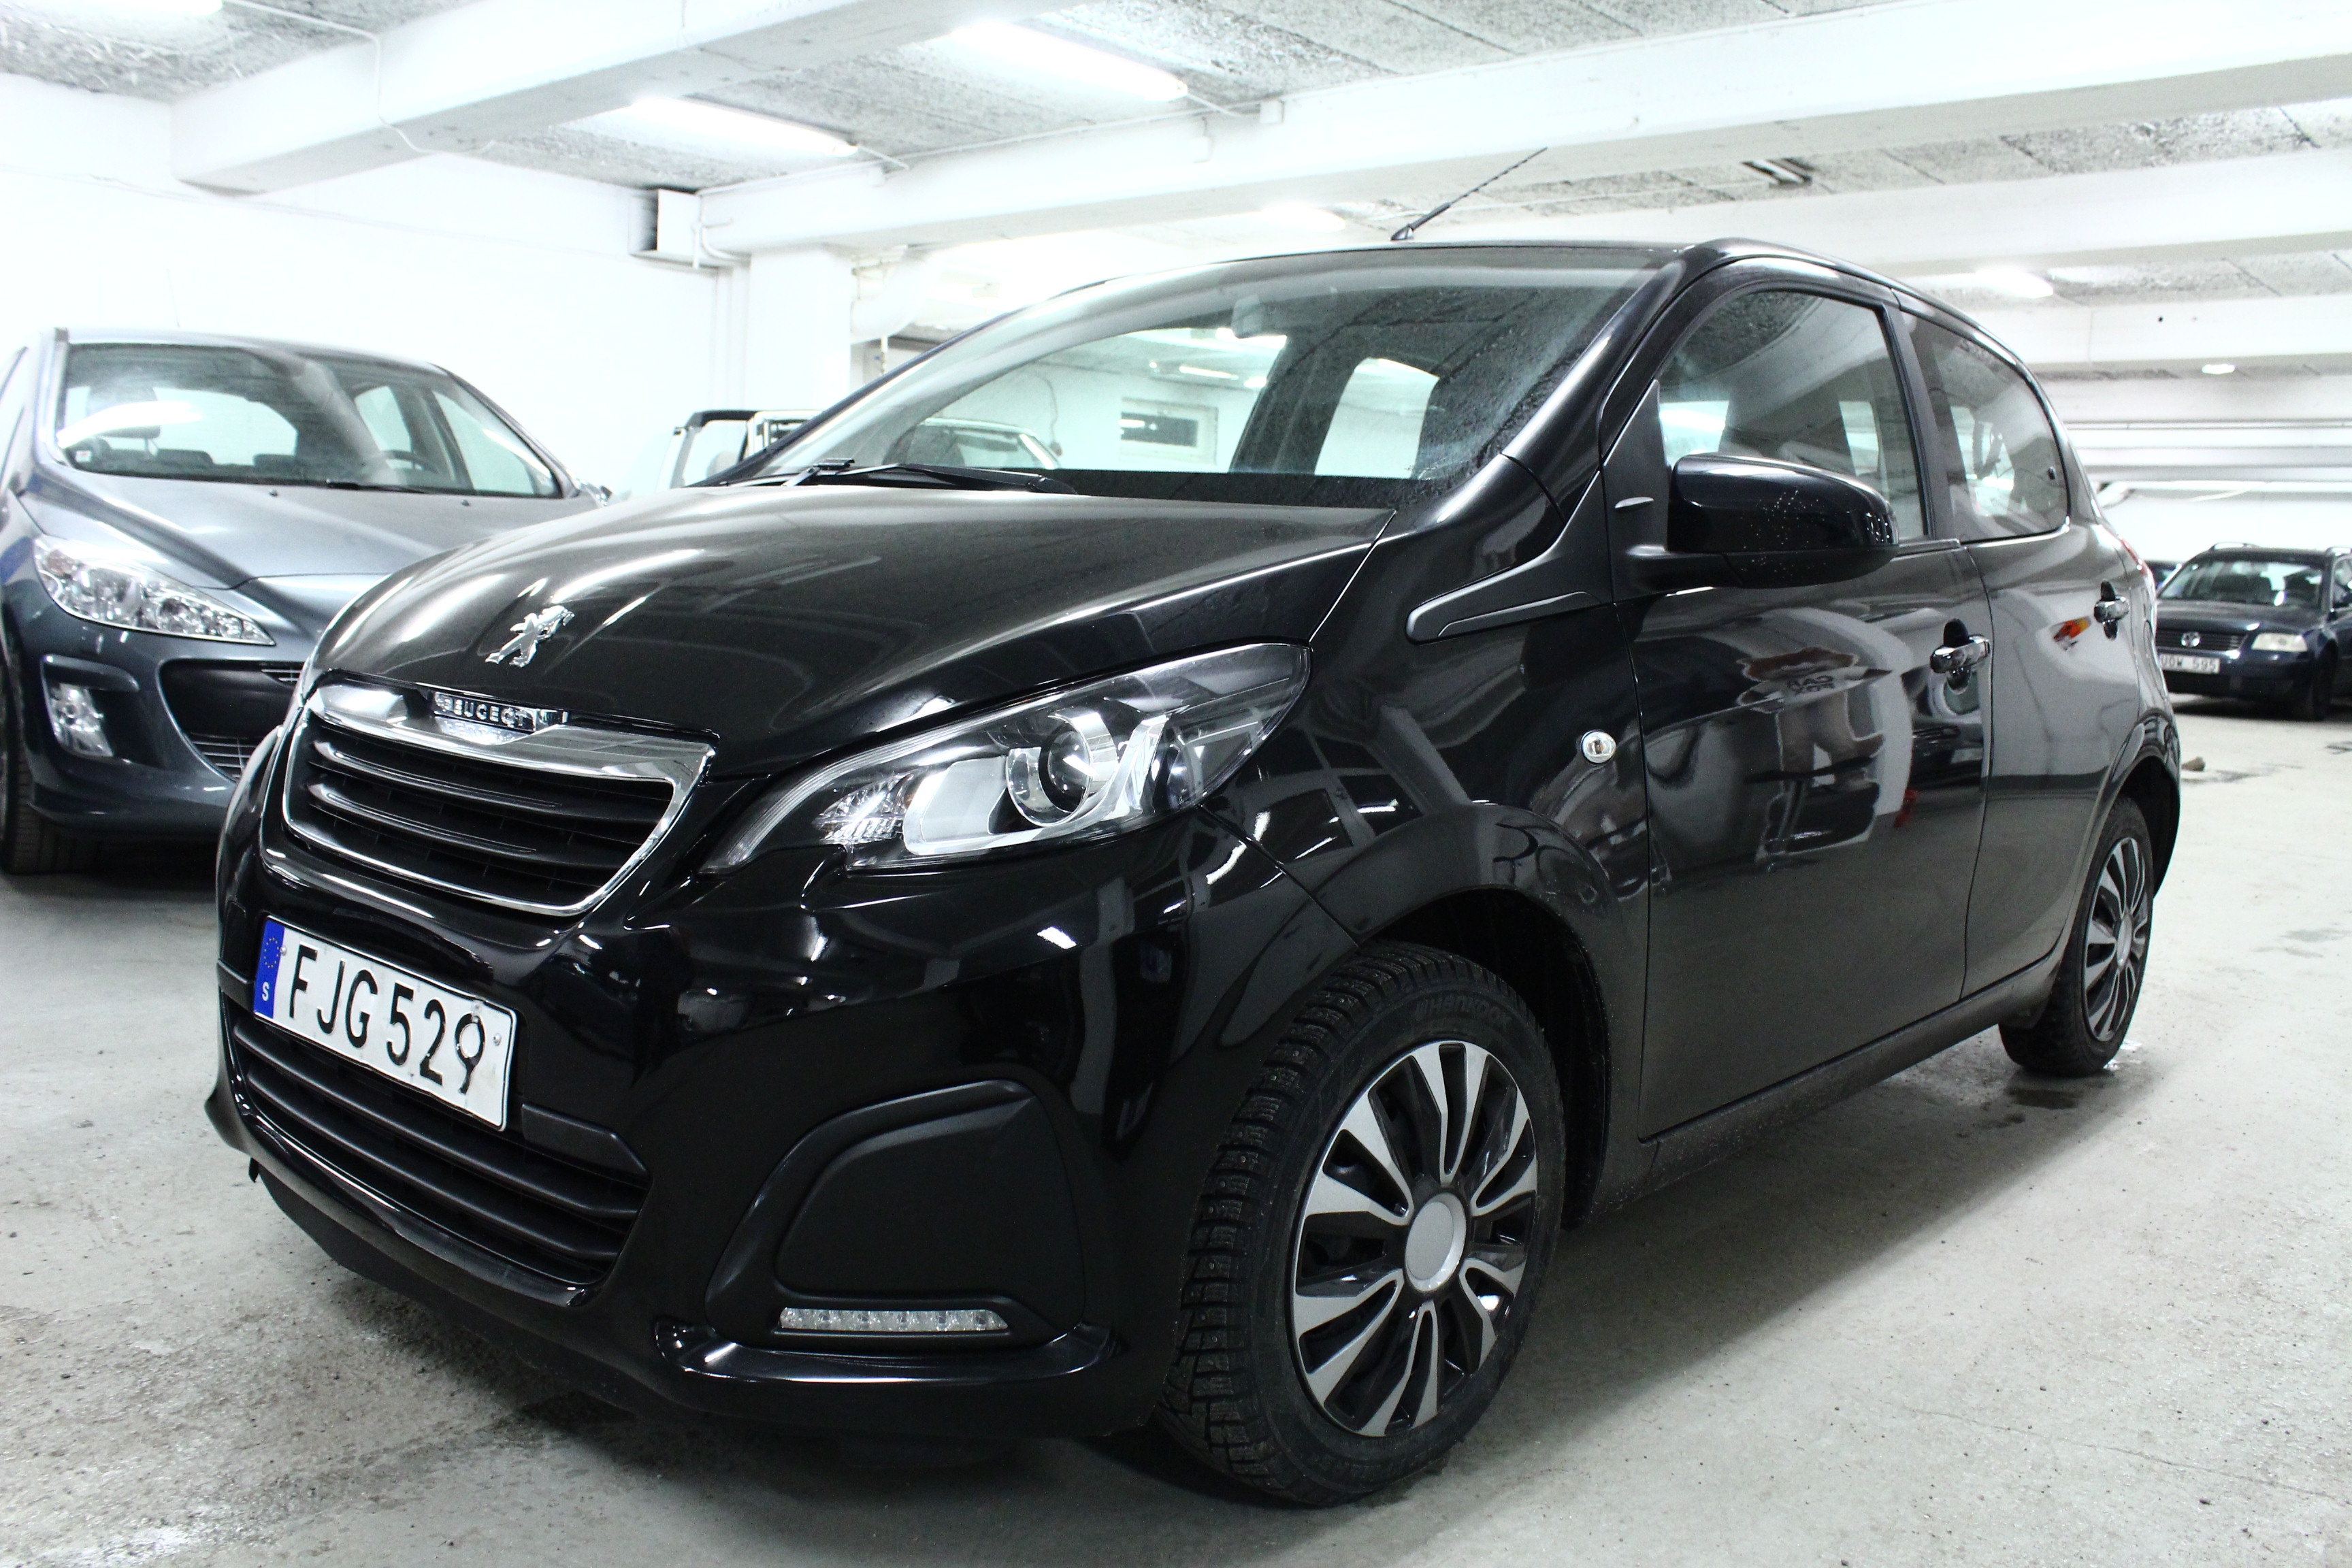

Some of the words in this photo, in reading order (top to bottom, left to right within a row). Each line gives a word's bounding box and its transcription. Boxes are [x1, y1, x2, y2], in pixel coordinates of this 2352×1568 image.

[441, 697, 527, 728] PEUGEOT
[262, 981, 270, 1001] S
[289, 943, 378, 1048] FJG
[386, 982, 485, 1094] 529
